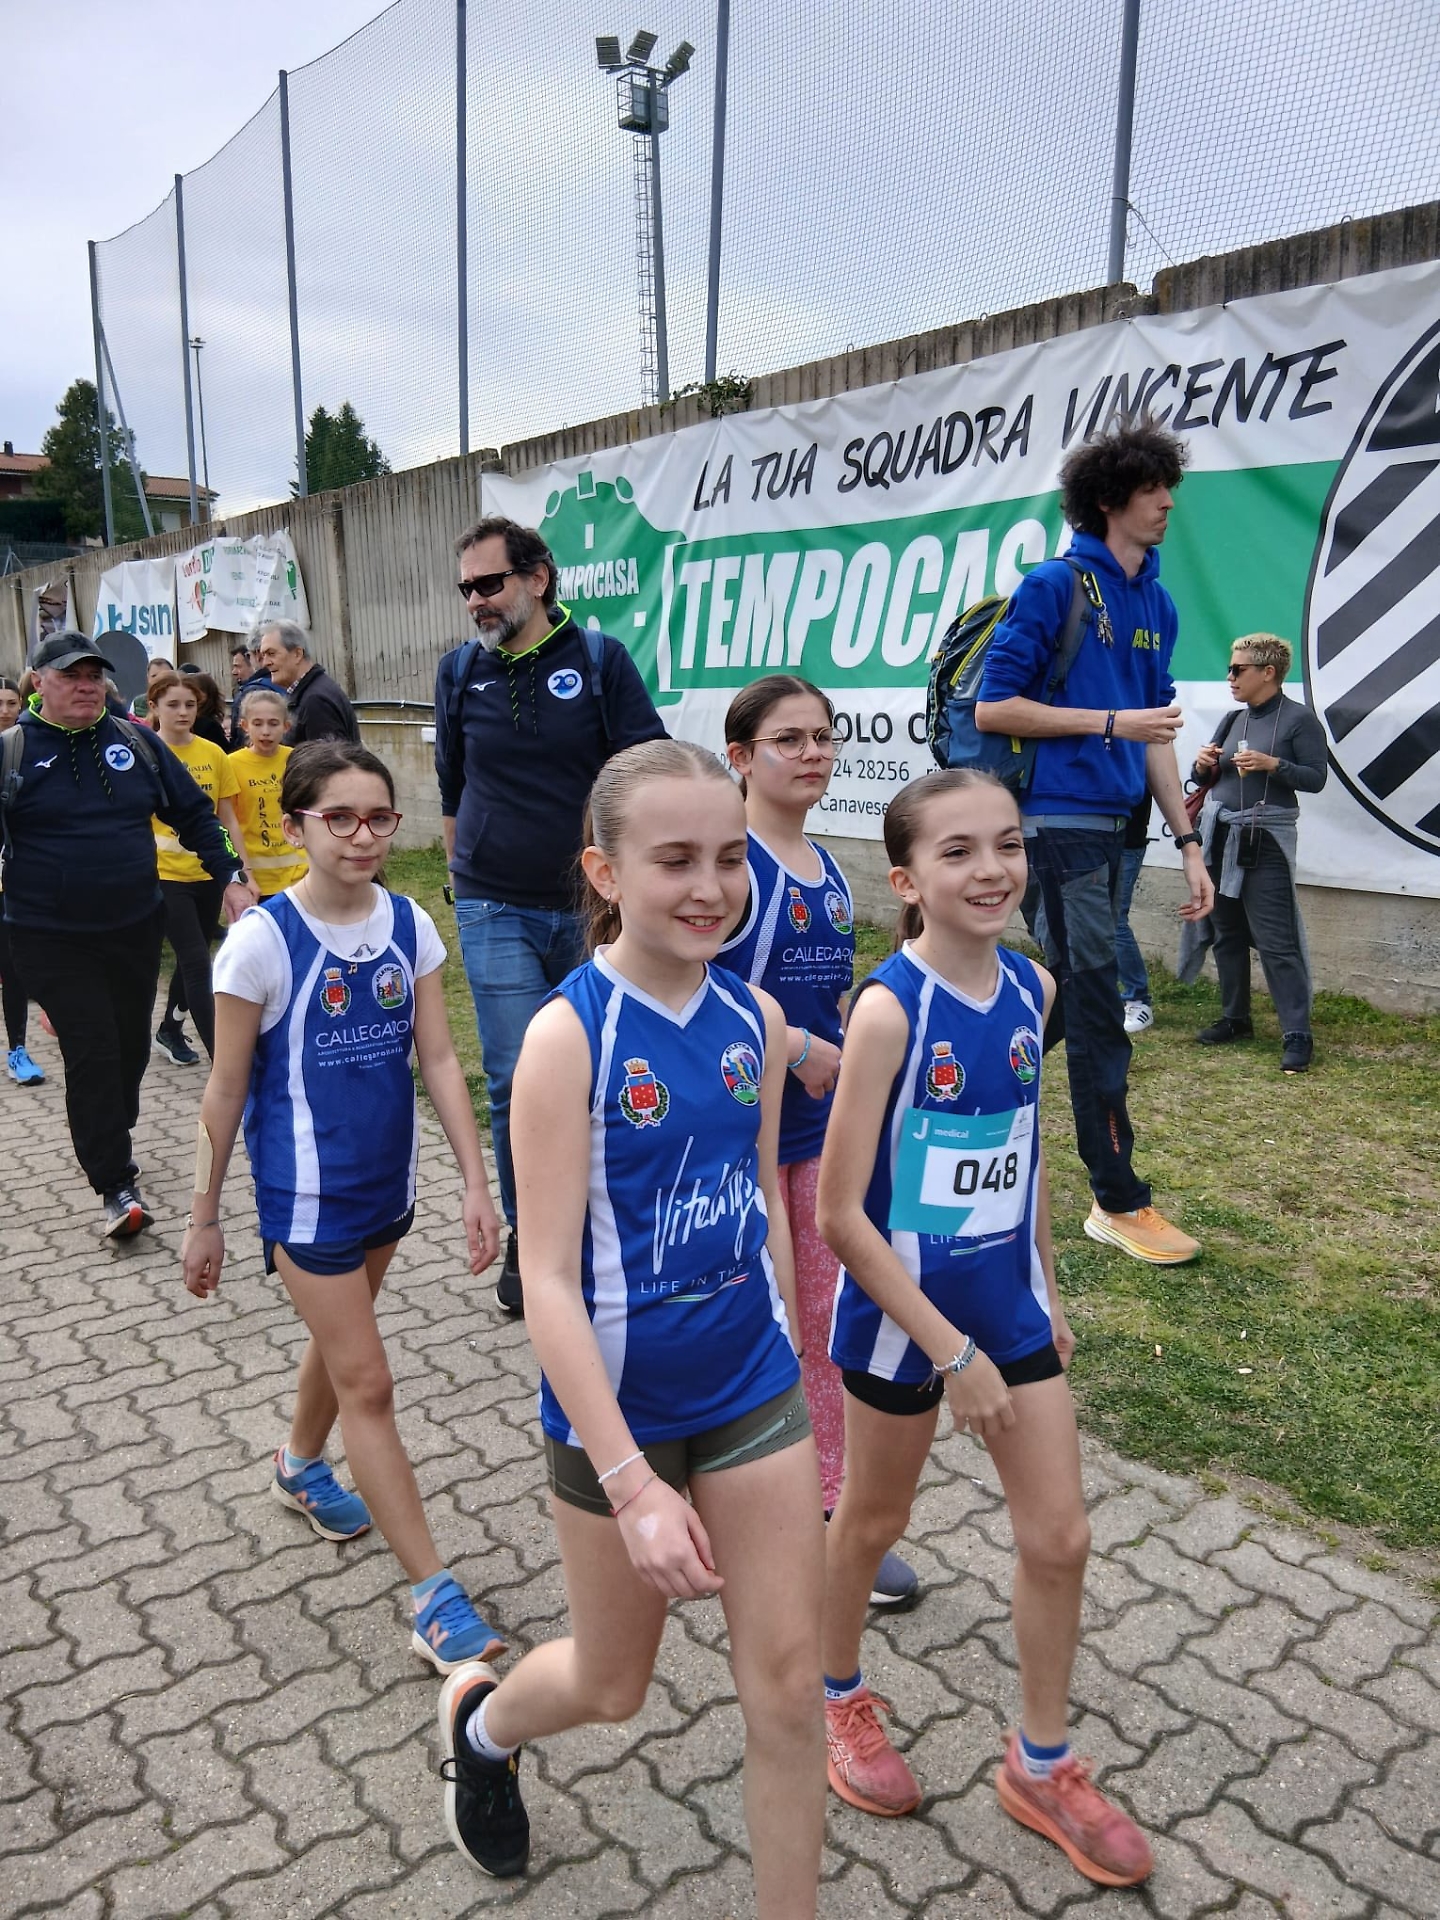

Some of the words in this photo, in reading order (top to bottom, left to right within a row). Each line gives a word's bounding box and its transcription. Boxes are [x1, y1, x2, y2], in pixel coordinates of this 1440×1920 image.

[693, 454, 733, 511] LA
[751, 442, 818, 502] TUA
[837, 394, 1034, 494] SQUADRA
[1061, 339, 1347, 449] VINCENTE
[556, 557, 640, 601] EMPOCASA
[678, 517, 1073, 670] TEMPOCAS
[552, 674, 578, 694] 20
[834, 712, 893, 744] OLO
[109, 749, 131, 766] 20
[856, 759, 910, 782] 28256
[819, 791, 889, 817] Canavese
[912, 1117, 929, 1140] J
[934, 1128, 969, 1139] medical
[953, 1151, 1018, 1196] 048
[640, 1281, 680, 1293] LIFE
[690, 1276, 708, 1287] IN
